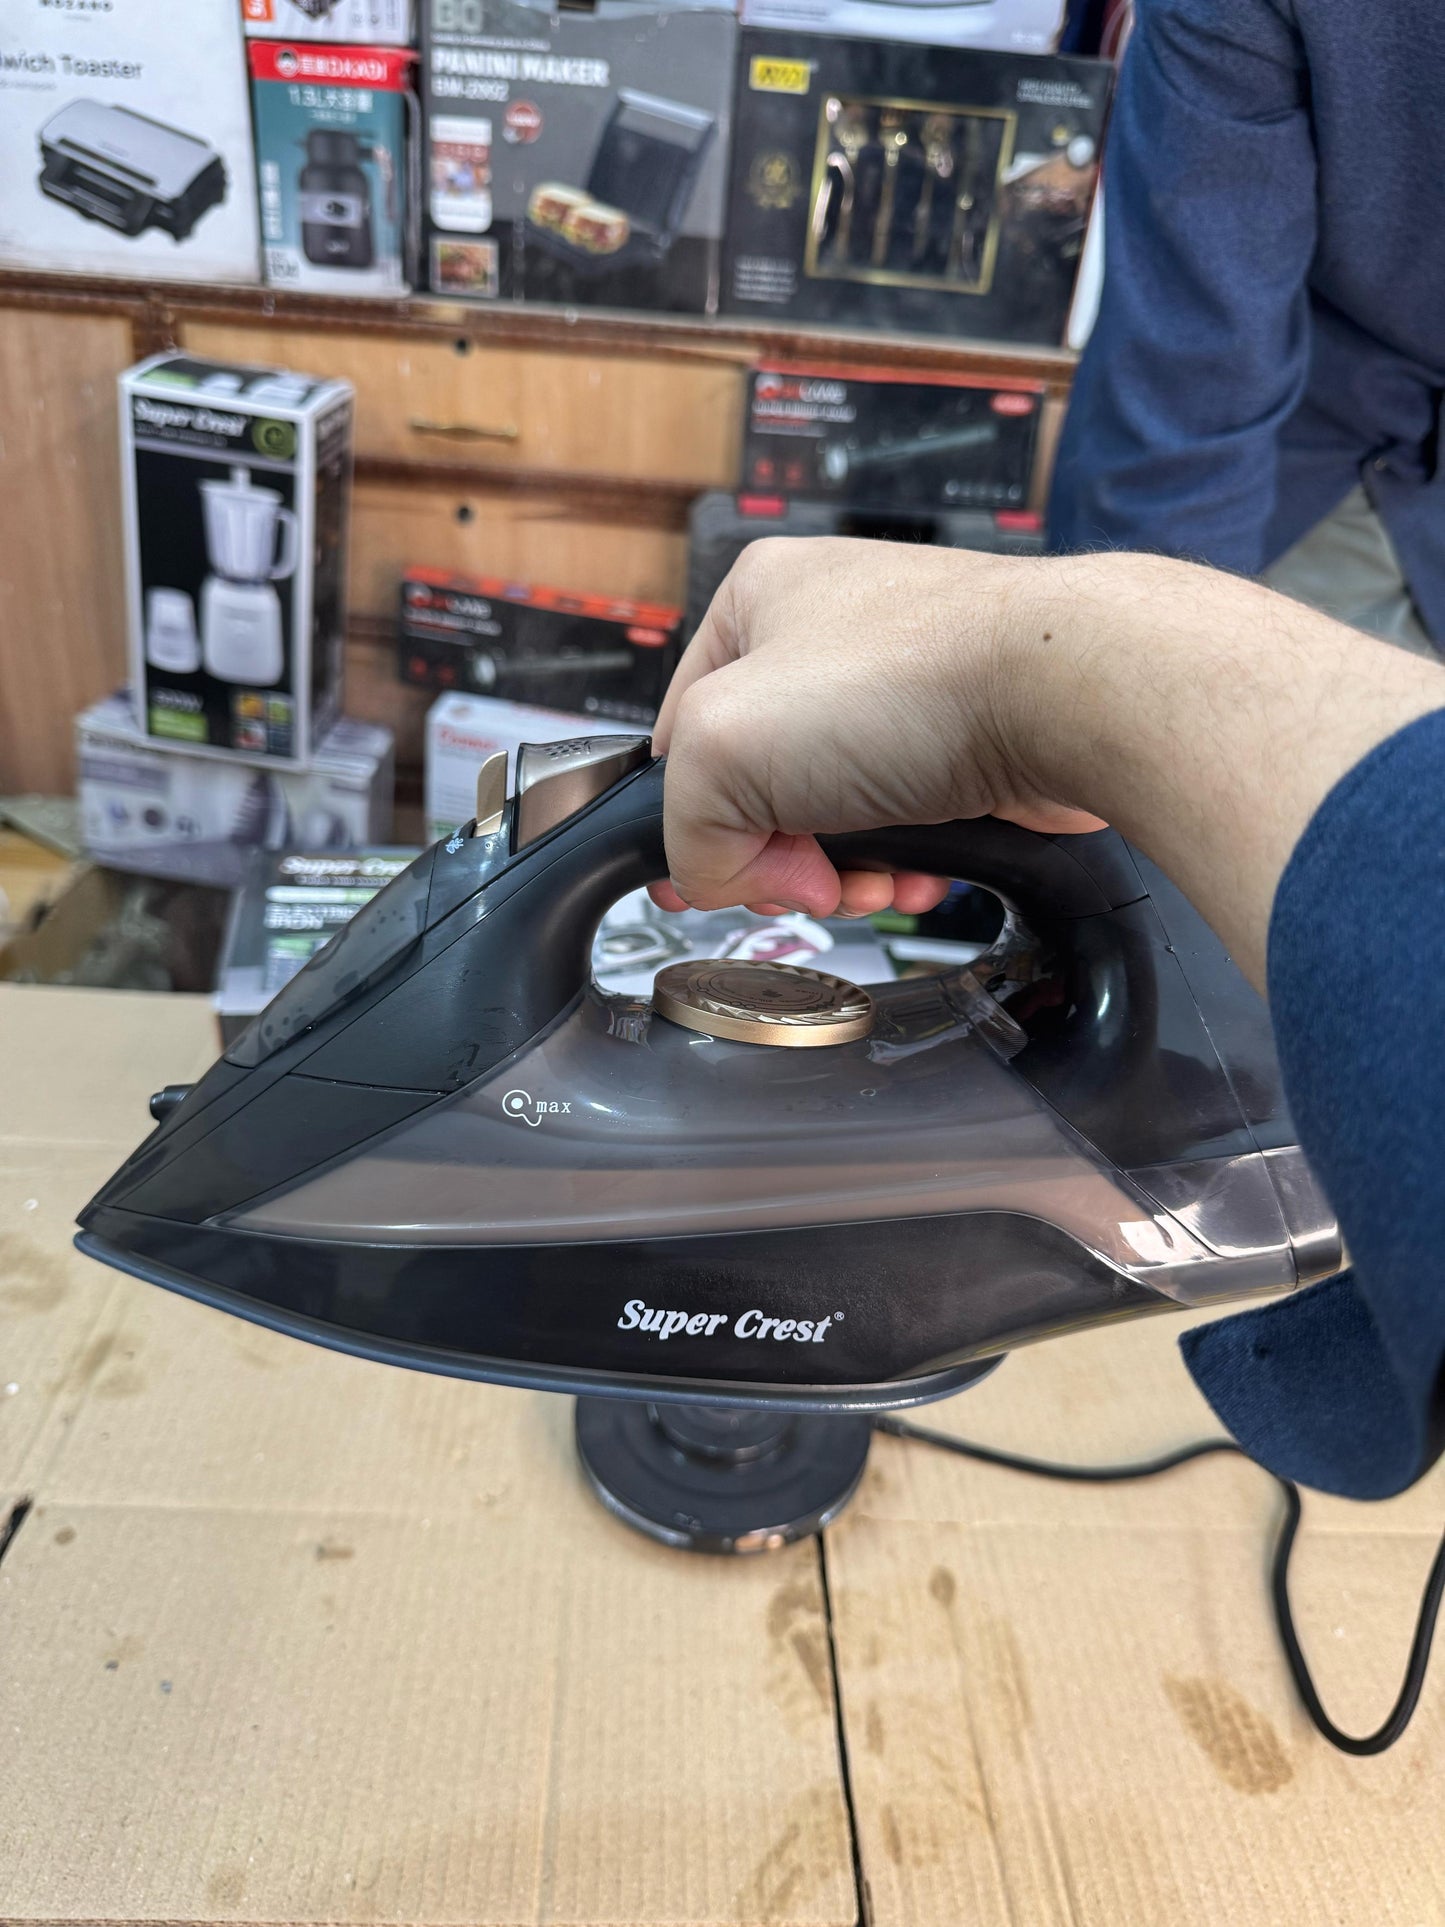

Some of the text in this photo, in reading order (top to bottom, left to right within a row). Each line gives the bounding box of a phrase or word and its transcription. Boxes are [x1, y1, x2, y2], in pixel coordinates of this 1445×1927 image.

[0, 51, 143, 79] wich Toaster
[431, 47, 610, 88] PANINI MAKER
[135, 398, 194, 428] Super
[191, 408, 248, 437] Crest
[279, 855, 360, 876] Super
[536, 1099, 572, 1114] max
[617, 1299, 833, 1342] Super Crest
